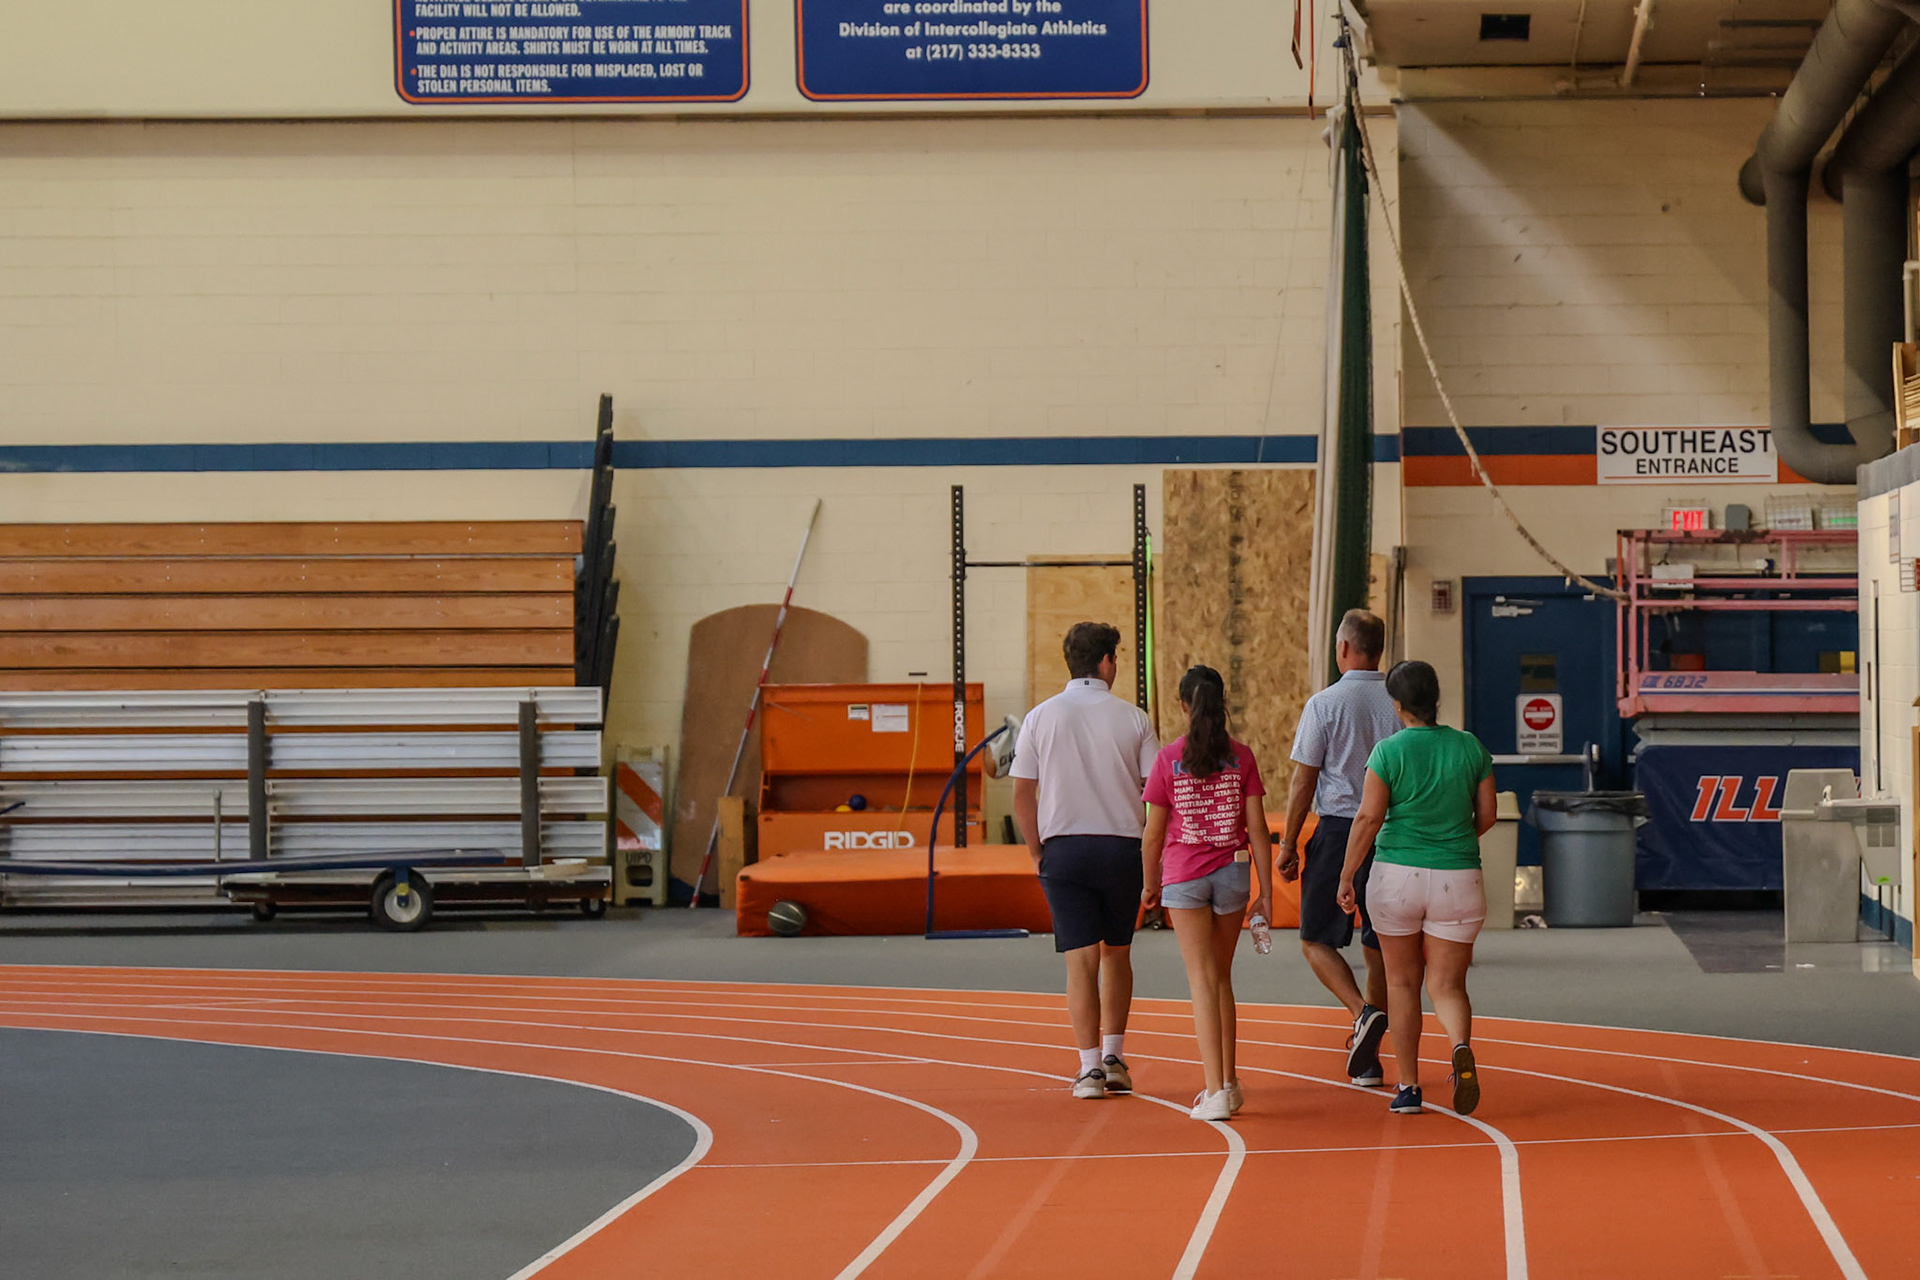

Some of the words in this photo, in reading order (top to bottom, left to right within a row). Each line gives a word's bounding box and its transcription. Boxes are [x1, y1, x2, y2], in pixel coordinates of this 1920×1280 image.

[416, 4, 460, 17] FACILITY
[463, 4, 488, 17] WILL
[491, 4, 511, 17] NOT
[515, 4, 528, 17] BE
[531, 4, 581, 17] ALLOWED.
[883, 2, 911, 14] are
[914, 0, 1008, 14] coordinated
[1012, 0, 1031, 16] by
[1035, 0, 1062, 13] the
[416, 26, 457, 40] PROPER
[459, 26, 493, 40] ATTIRE
[496, 26, 506, 40] IS
[509, 26, 569, 40] MANDATORY
[572, 26, 592, 40] FOR
[595, 26, 614, 40] USE
[616, 26, 630, 40] OF
[632, 26, 651, 40] THE
[654, 26, 696, 40] ARMORY
[699, 26, 732, 40] TRACK
[839, 22, 900, 36] Division
[904, 22, 921, 36] of
[924, 21, 1037, 39] Intercollegiate
[1041, 20, 1107, 35] Athletics
[416, 42, 437, 55] AND
[439, 42, 483, 55] ACTIVITY
[486, 42, 520, 55] AREAS.
[523, 42, 560, 55] SHIRTS
[562, 42, 589, 55] MUST
[593, 42, 605, 55] BE
[608, 42, 638, 55] WORN
[641, 42, 653, 55] AT
[655, 42, 674, 55] ALL
[675, 42, 708, 55] TIMES.
[905, 46, 922, 60] at
[925, 44, 964, 61] (217)
[967, 43, 1041, 59] 333-8333
[417, 64, 437, 78] THE
[440, 64, 458, 78] DIA
[461, 64, 471, 78] IS
[475, 64, 495, 78] NOT
[498, 64, 568, 78] RESPONSIBLE
[571, 64, 591, 78] FOR
[595, 64, 657, 78] MISPLACED,
[660, 64, 686, 78] LOST
[688, 64, 704, 78] OR
[417, 80, 457, 93] STOLEN
[460, 80, 514, 93] PERSONAL
[516, 80, 552, 93] ITEMS.
[1601, 429, 1771, 455] SOUTHEAST
[1636, 457, 1739, 474] ENTRANCE
[1672, 510, 1704, 531] EXIT
[1174, 779, 1189, 787] NEW
[1174, 786, 1194, 794] MIAMI
[1174, 793, 1201, 801] LONDON
[824, 831, 914, 850] RIDGID
